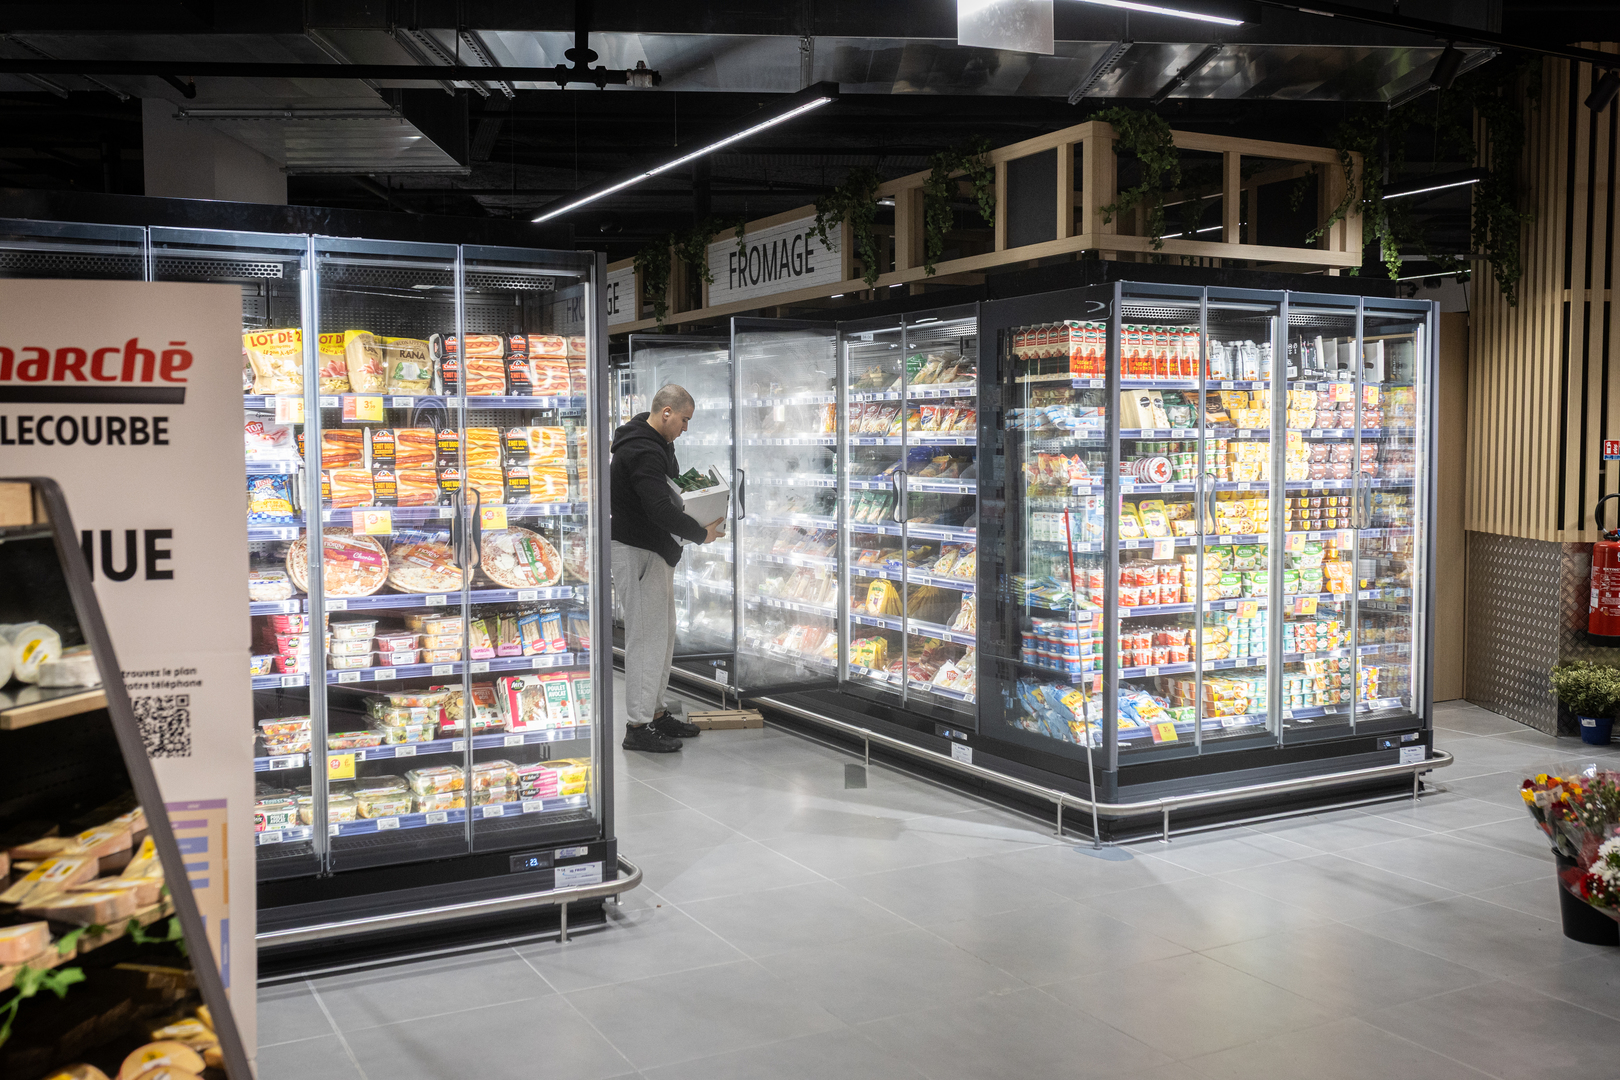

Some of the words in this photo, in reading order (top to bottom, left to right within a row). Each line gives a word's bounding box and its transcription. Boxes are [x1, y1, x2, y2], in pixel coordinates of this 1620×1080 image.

[729, 233, 815, 290] FROMAGE
[250, 333, 274, 348] LOT
[278, 332, 294, 344] DE
[296, 331, 302, 342] 2
[318, 334, 334, 344] OT
[400, 350, 426, 360] RANA
[0, 415, 170, 446] LECOURBE
[248, 423, 262, 434] TOP
[163, 668, 172, 678] le
[174, 667, 198, 679] plan
[152, 679, 203, 692] téléphone
[547, 684, 565, 692] POULET
